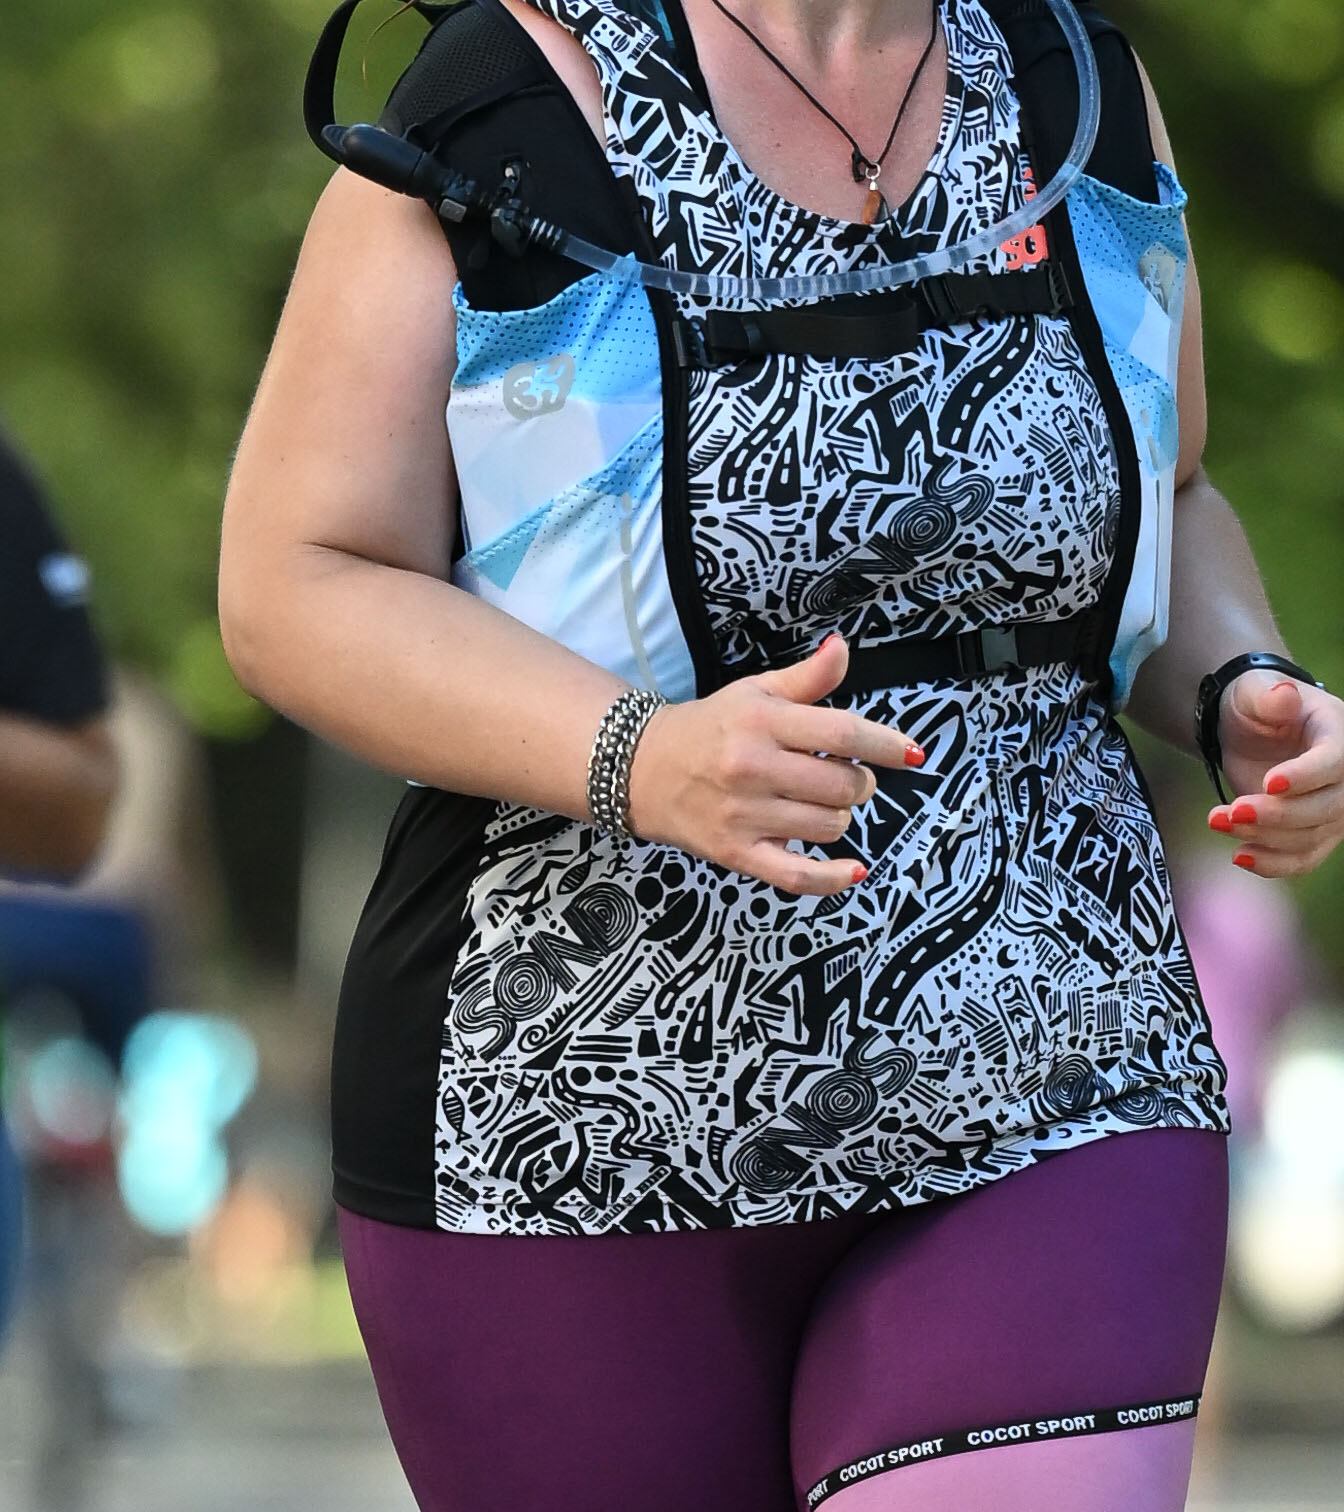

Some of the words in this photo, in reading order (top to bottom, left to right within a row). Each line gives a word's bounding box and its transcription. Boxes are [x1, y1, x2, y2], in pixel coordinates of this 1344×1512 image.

[839, 1454, 885, 1482] COCOT
[887, 1438, 944, 1464] SPORT
[967, 1423, 1031, 1446] COCOT
[1036, 1414, 1096, 1436] SPORT
[1117, 1407, 1163, 1425] COCOT
